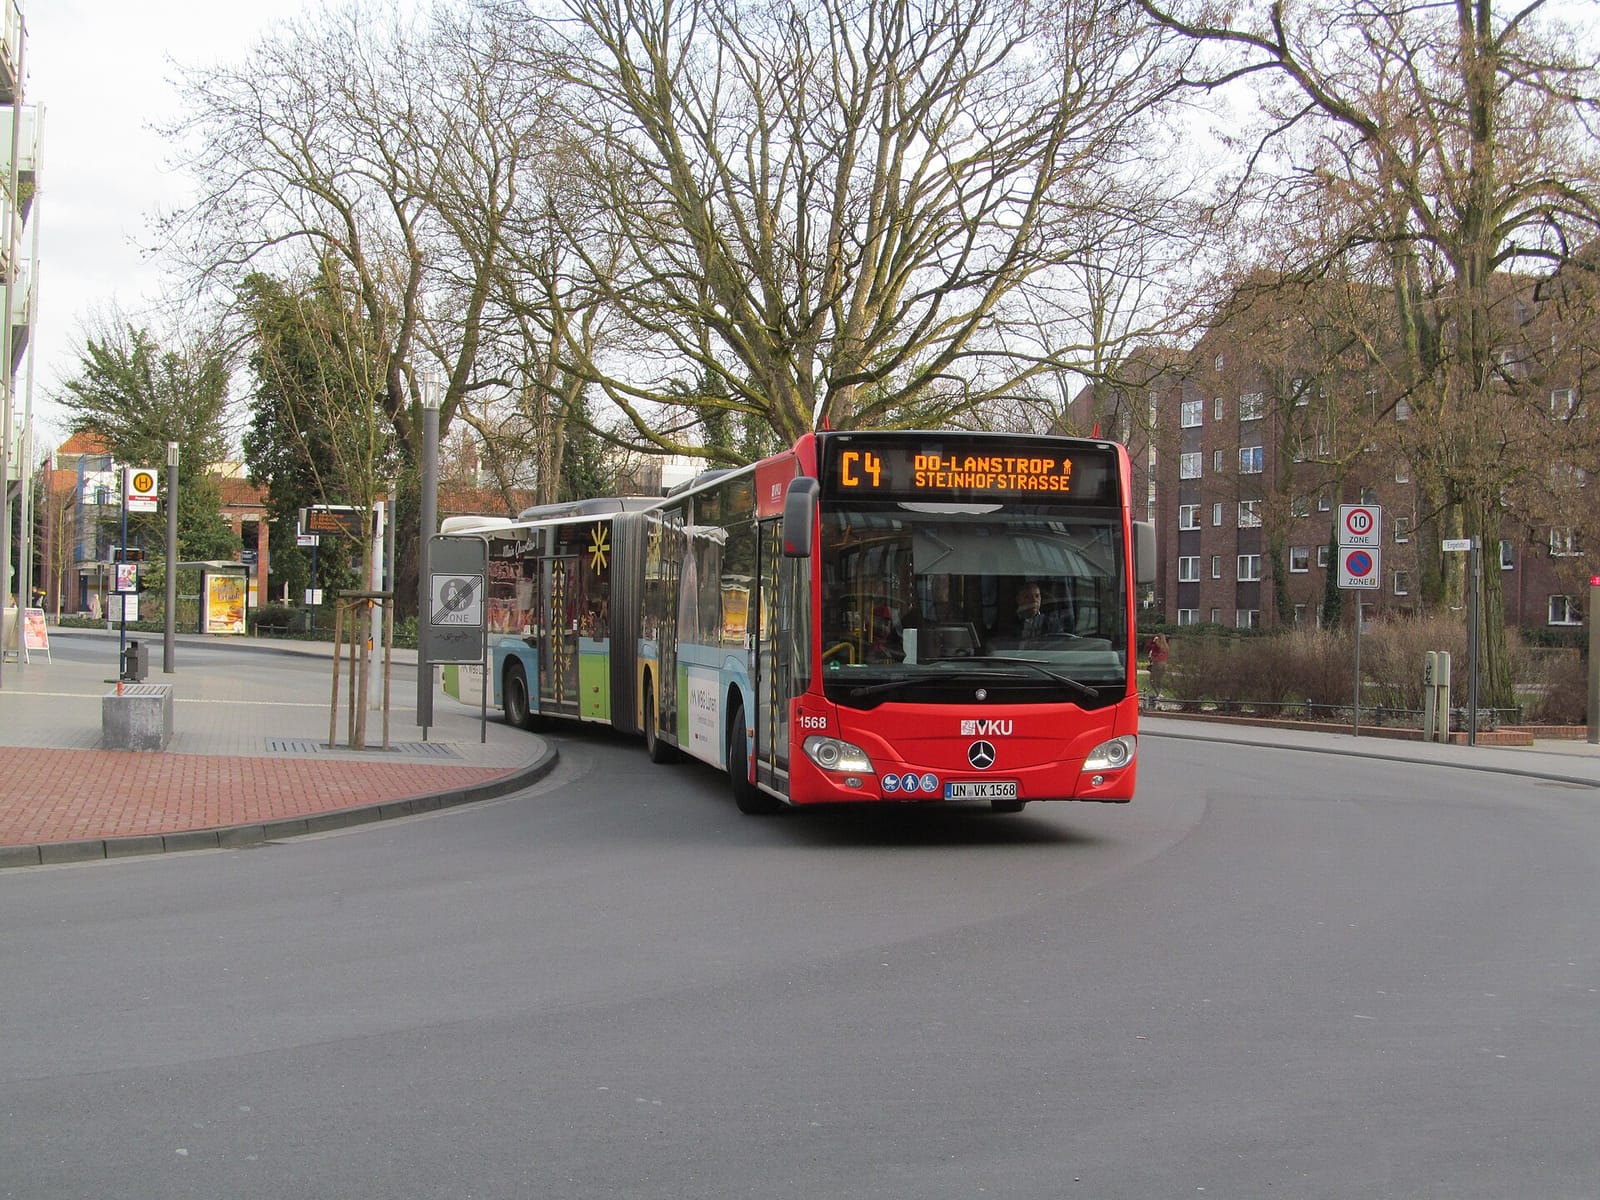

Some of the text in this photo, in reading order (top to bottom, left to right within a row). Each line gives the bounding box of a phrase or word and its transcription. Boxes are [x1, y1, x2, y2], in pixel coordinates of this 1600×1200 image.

[842, 452, 881, 487] C4
[914, 455, 1055, 475] DO-LANSTROP
[138, 477, 149, 489] H
[915, 472, 1070, 491] STEINHOFSTRASSE
[1353, 516, 1366, 528] 10
[1349, 536, 1369, 544] ZONE
[1348, 577, 1369, 586] ZONE
[444, 614, 469, 623] ZONE
[799, 715, 827, 729] 1568
[976, 720, 1013, 736] VKU
[952, 784, 1015, 797] UN VK 1568
